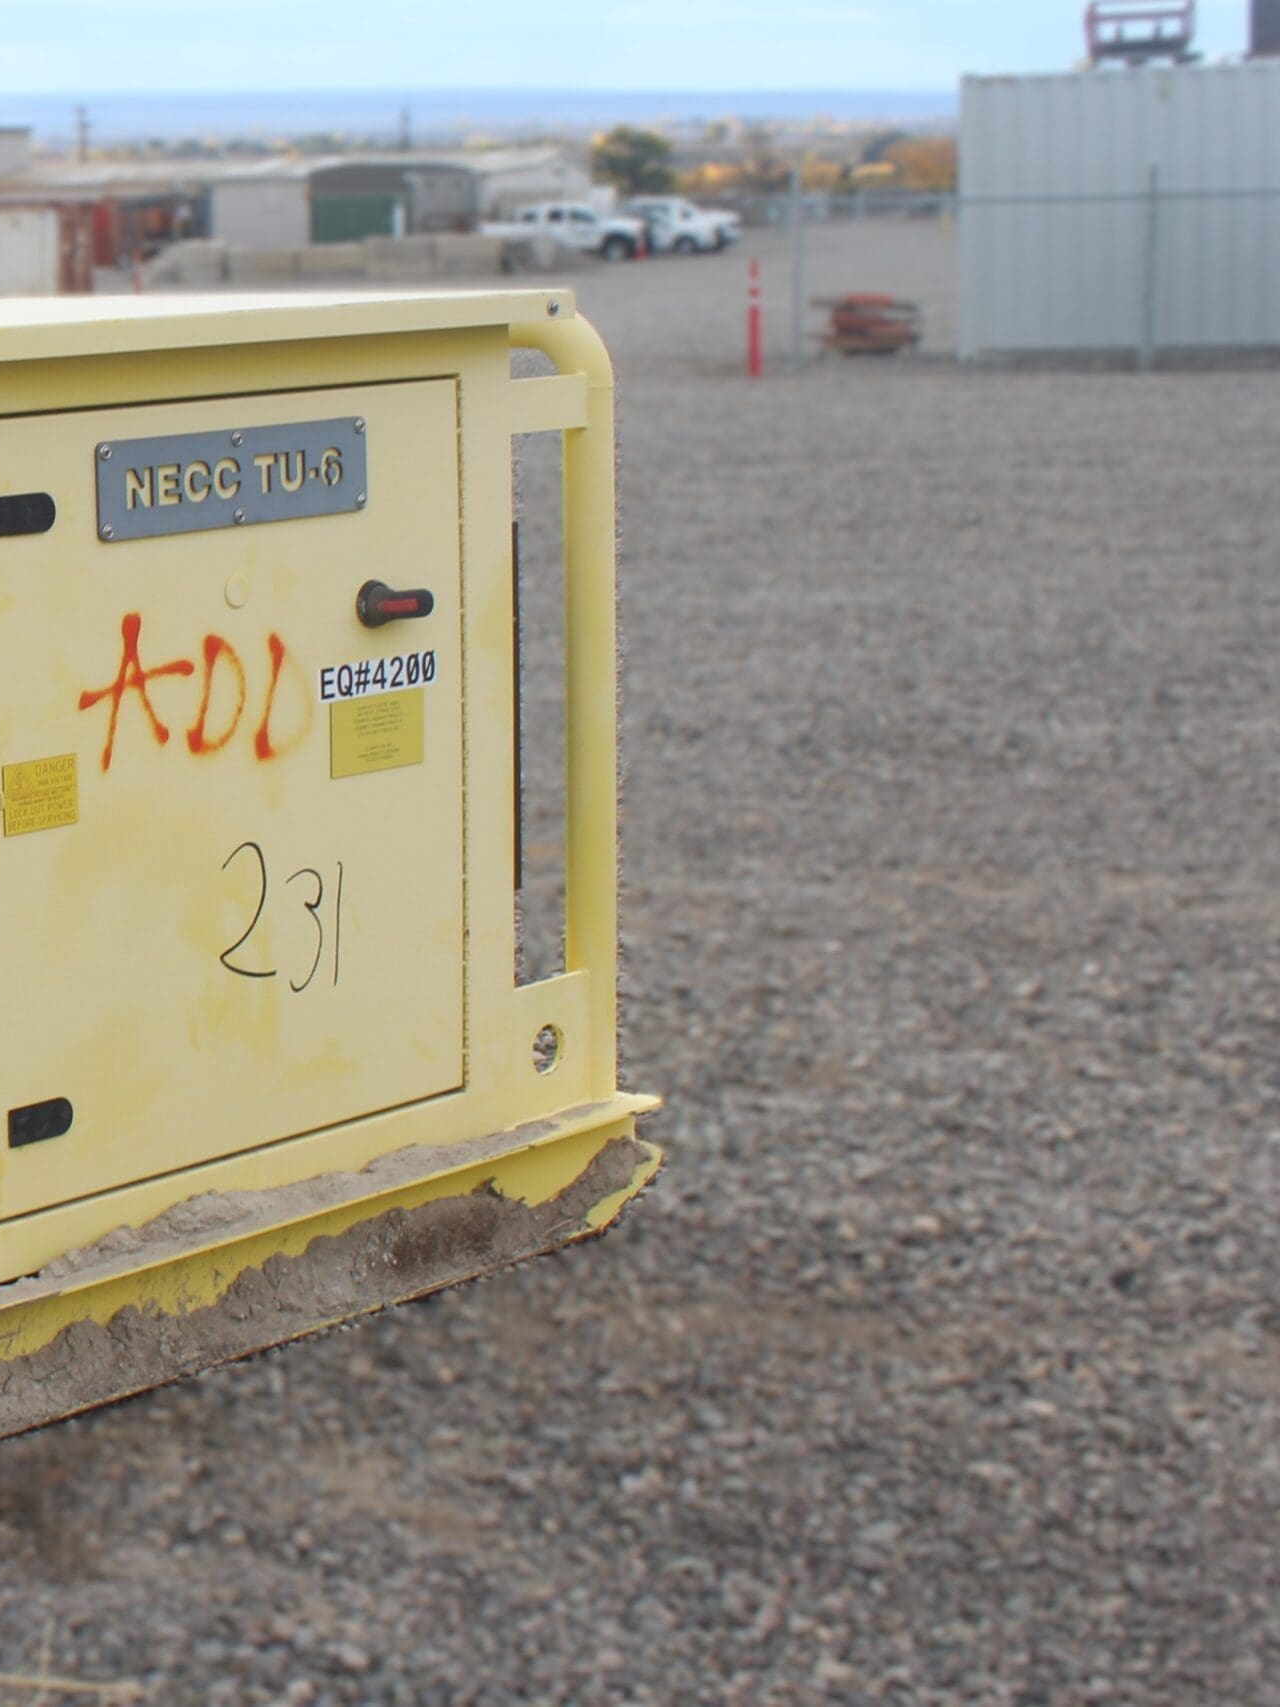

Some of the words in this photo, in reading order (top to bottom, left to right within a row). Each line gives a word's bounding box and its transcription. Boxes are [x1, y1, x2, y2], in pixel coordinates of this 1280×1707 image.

[125, 456, 241, 510] NECC
[254, 446, 343, 494] TU-6
[78, 612, 312, 773] ADD
[320, 649, 436, 701] EQ#4200
[35, 758, 74, 777] DANGER
[31, 803, 45, 815] OUT
[220, 841, 343, 993] 231
